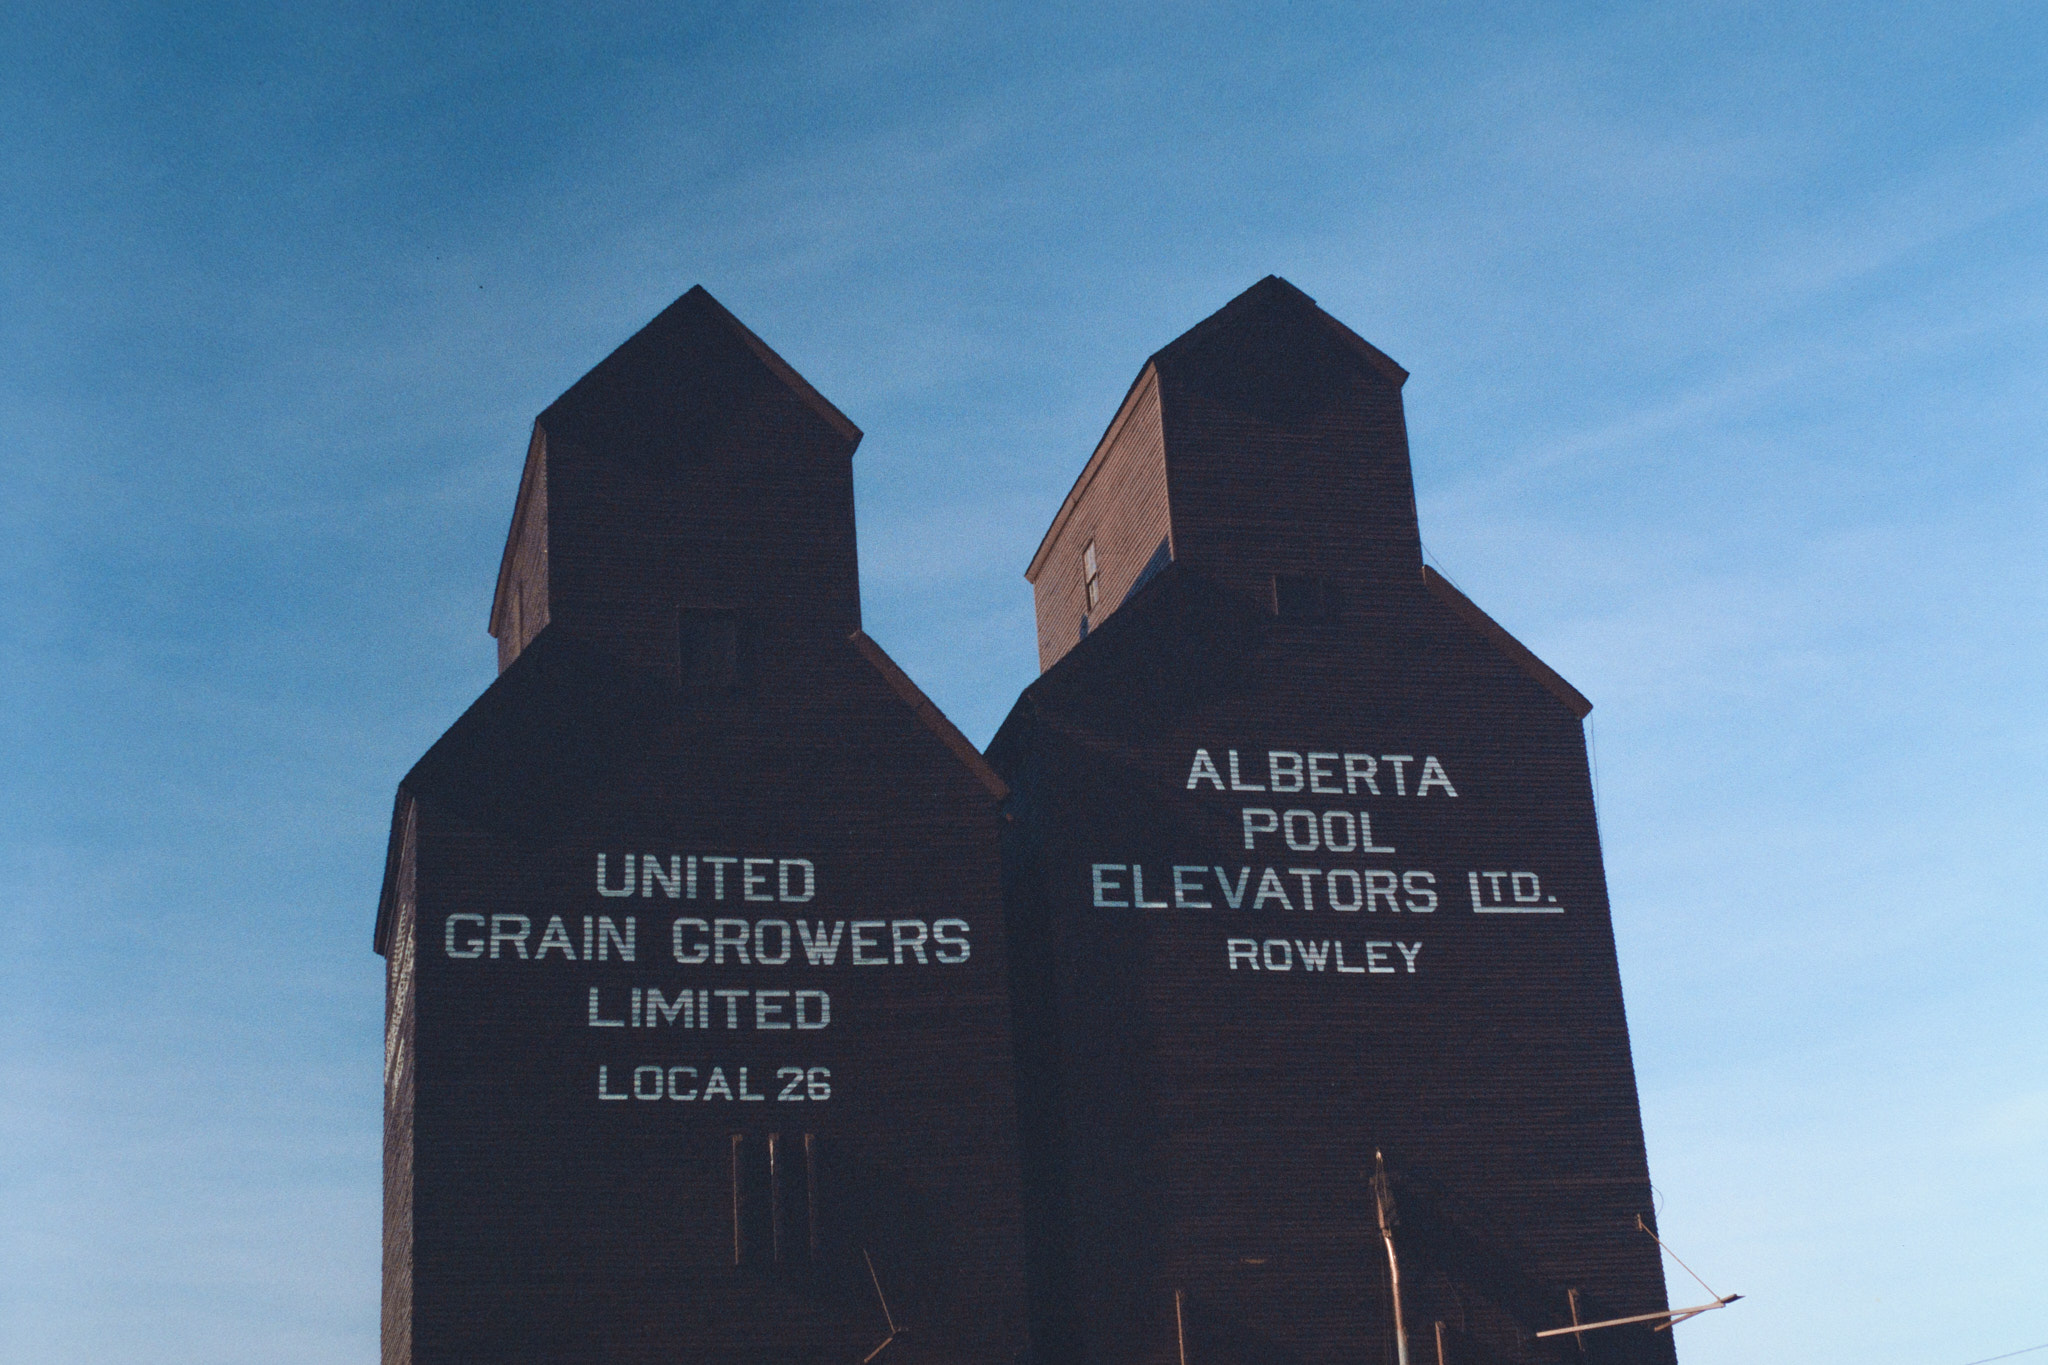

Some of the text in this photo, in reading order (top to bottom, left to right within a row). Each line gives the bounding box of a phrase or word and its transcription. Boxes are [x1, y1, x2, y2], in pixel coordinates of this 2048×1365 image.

[1185, 748, 1459, 798] ALBERTA
[1241, 807, 1396, 854] POOL
[596, 852, 817, 903] UNITED
[1091, 863, 1566, 915] ELEVATORS LTD.
[444, 912, 972, 966] GRAIN GROWERS
[1226, 937, 1424, 975] ROWLEY
[588, 986, 832, 1030] LIMITED
[598, 1065, 832, 1102] LOCAL 26
